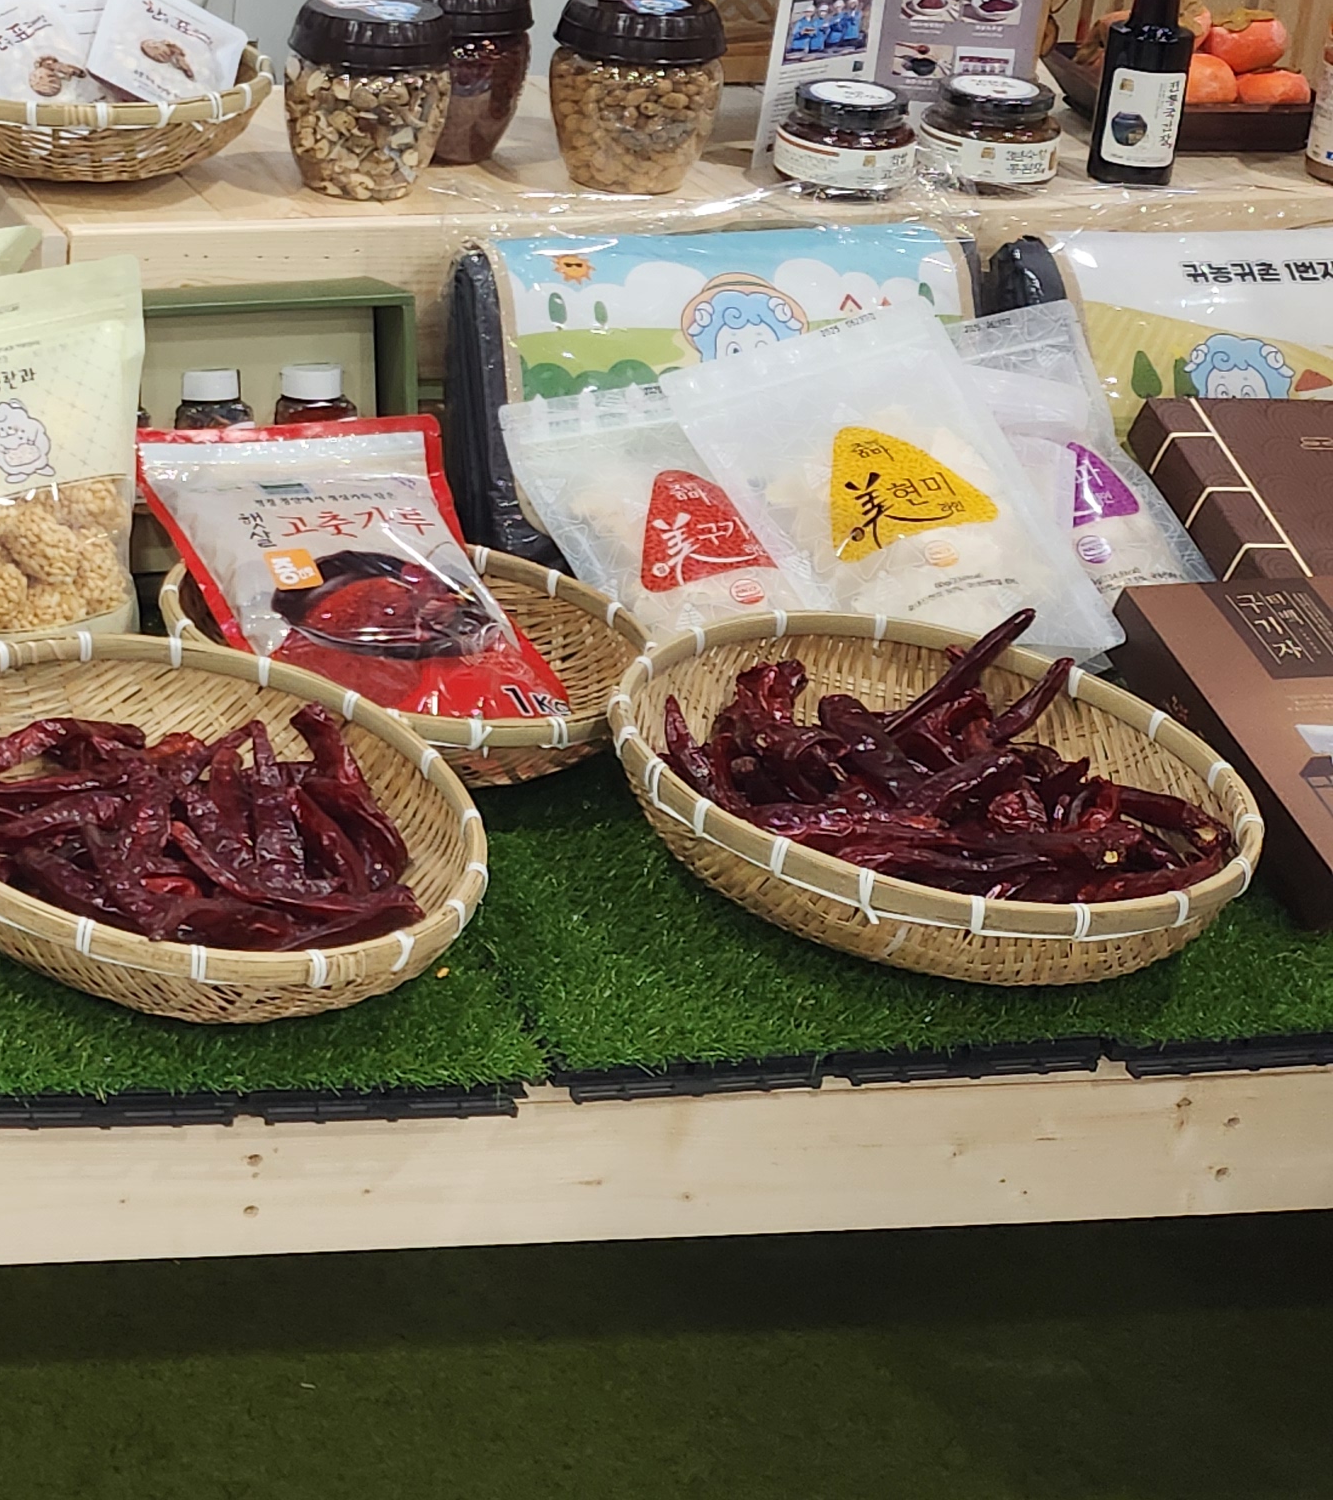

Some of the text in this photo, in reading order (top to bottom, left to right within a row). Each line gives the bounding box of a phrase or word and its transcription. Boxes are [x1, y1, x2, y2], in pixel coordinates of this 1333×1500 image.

[1182, 261, 1281, 284] 귀농귀촌
[886, 472, 956, 506] 현미
[277, 506, 436, 540] 고춧가루
[696, 516, 753, 546] 구기
[1236, 593, 1303, 660] 구기자
